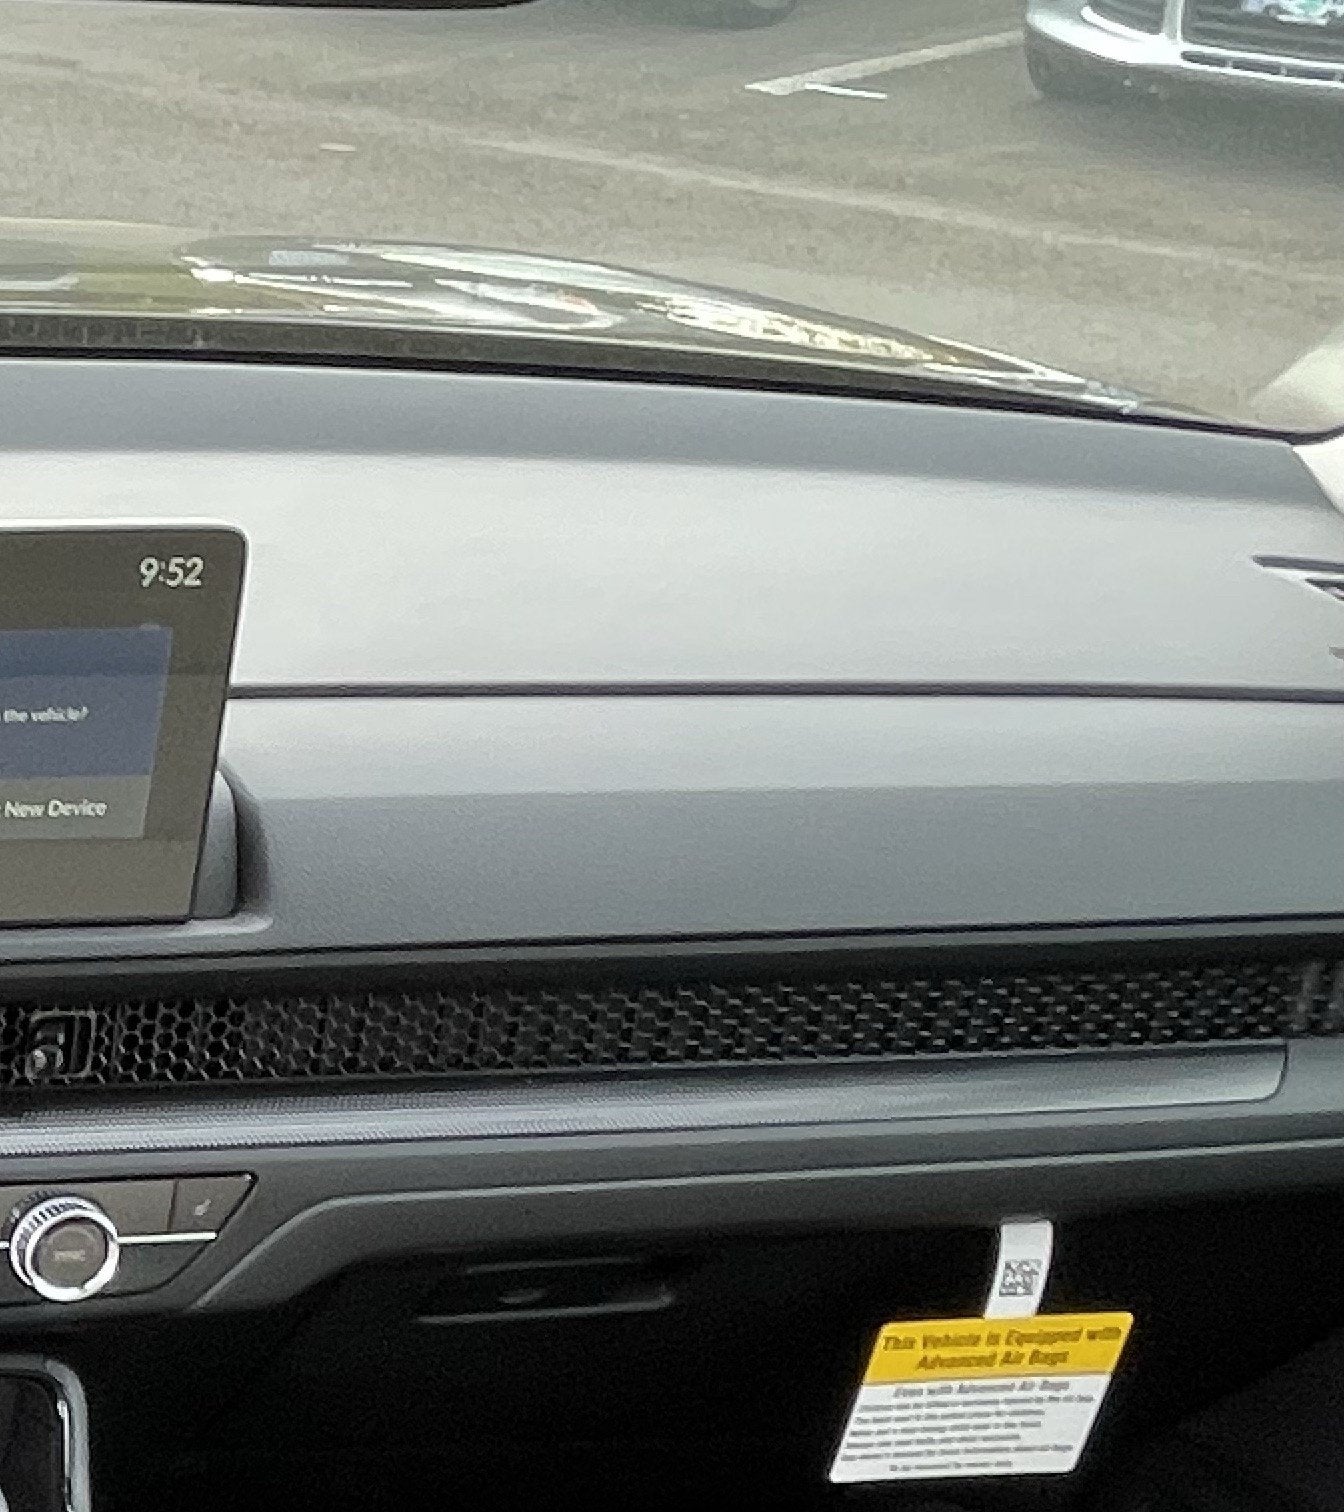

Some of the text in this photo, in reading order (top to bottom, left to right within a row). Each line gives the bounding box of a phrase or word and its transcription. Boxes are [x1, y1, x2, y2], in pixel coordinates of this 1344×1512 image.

[140, 556, 204, 588] 9:52
[3, 708, 27, 723] the
[31, 706, 89, 723] vehicle?
[6, 801, 45, 818] New
[49, 799, 108, 818] Device
[882, 1326, 1122, 1351] This Vehicle is Equipped with
[917, 1350, 1070, 1371] Advanced Air Bags
